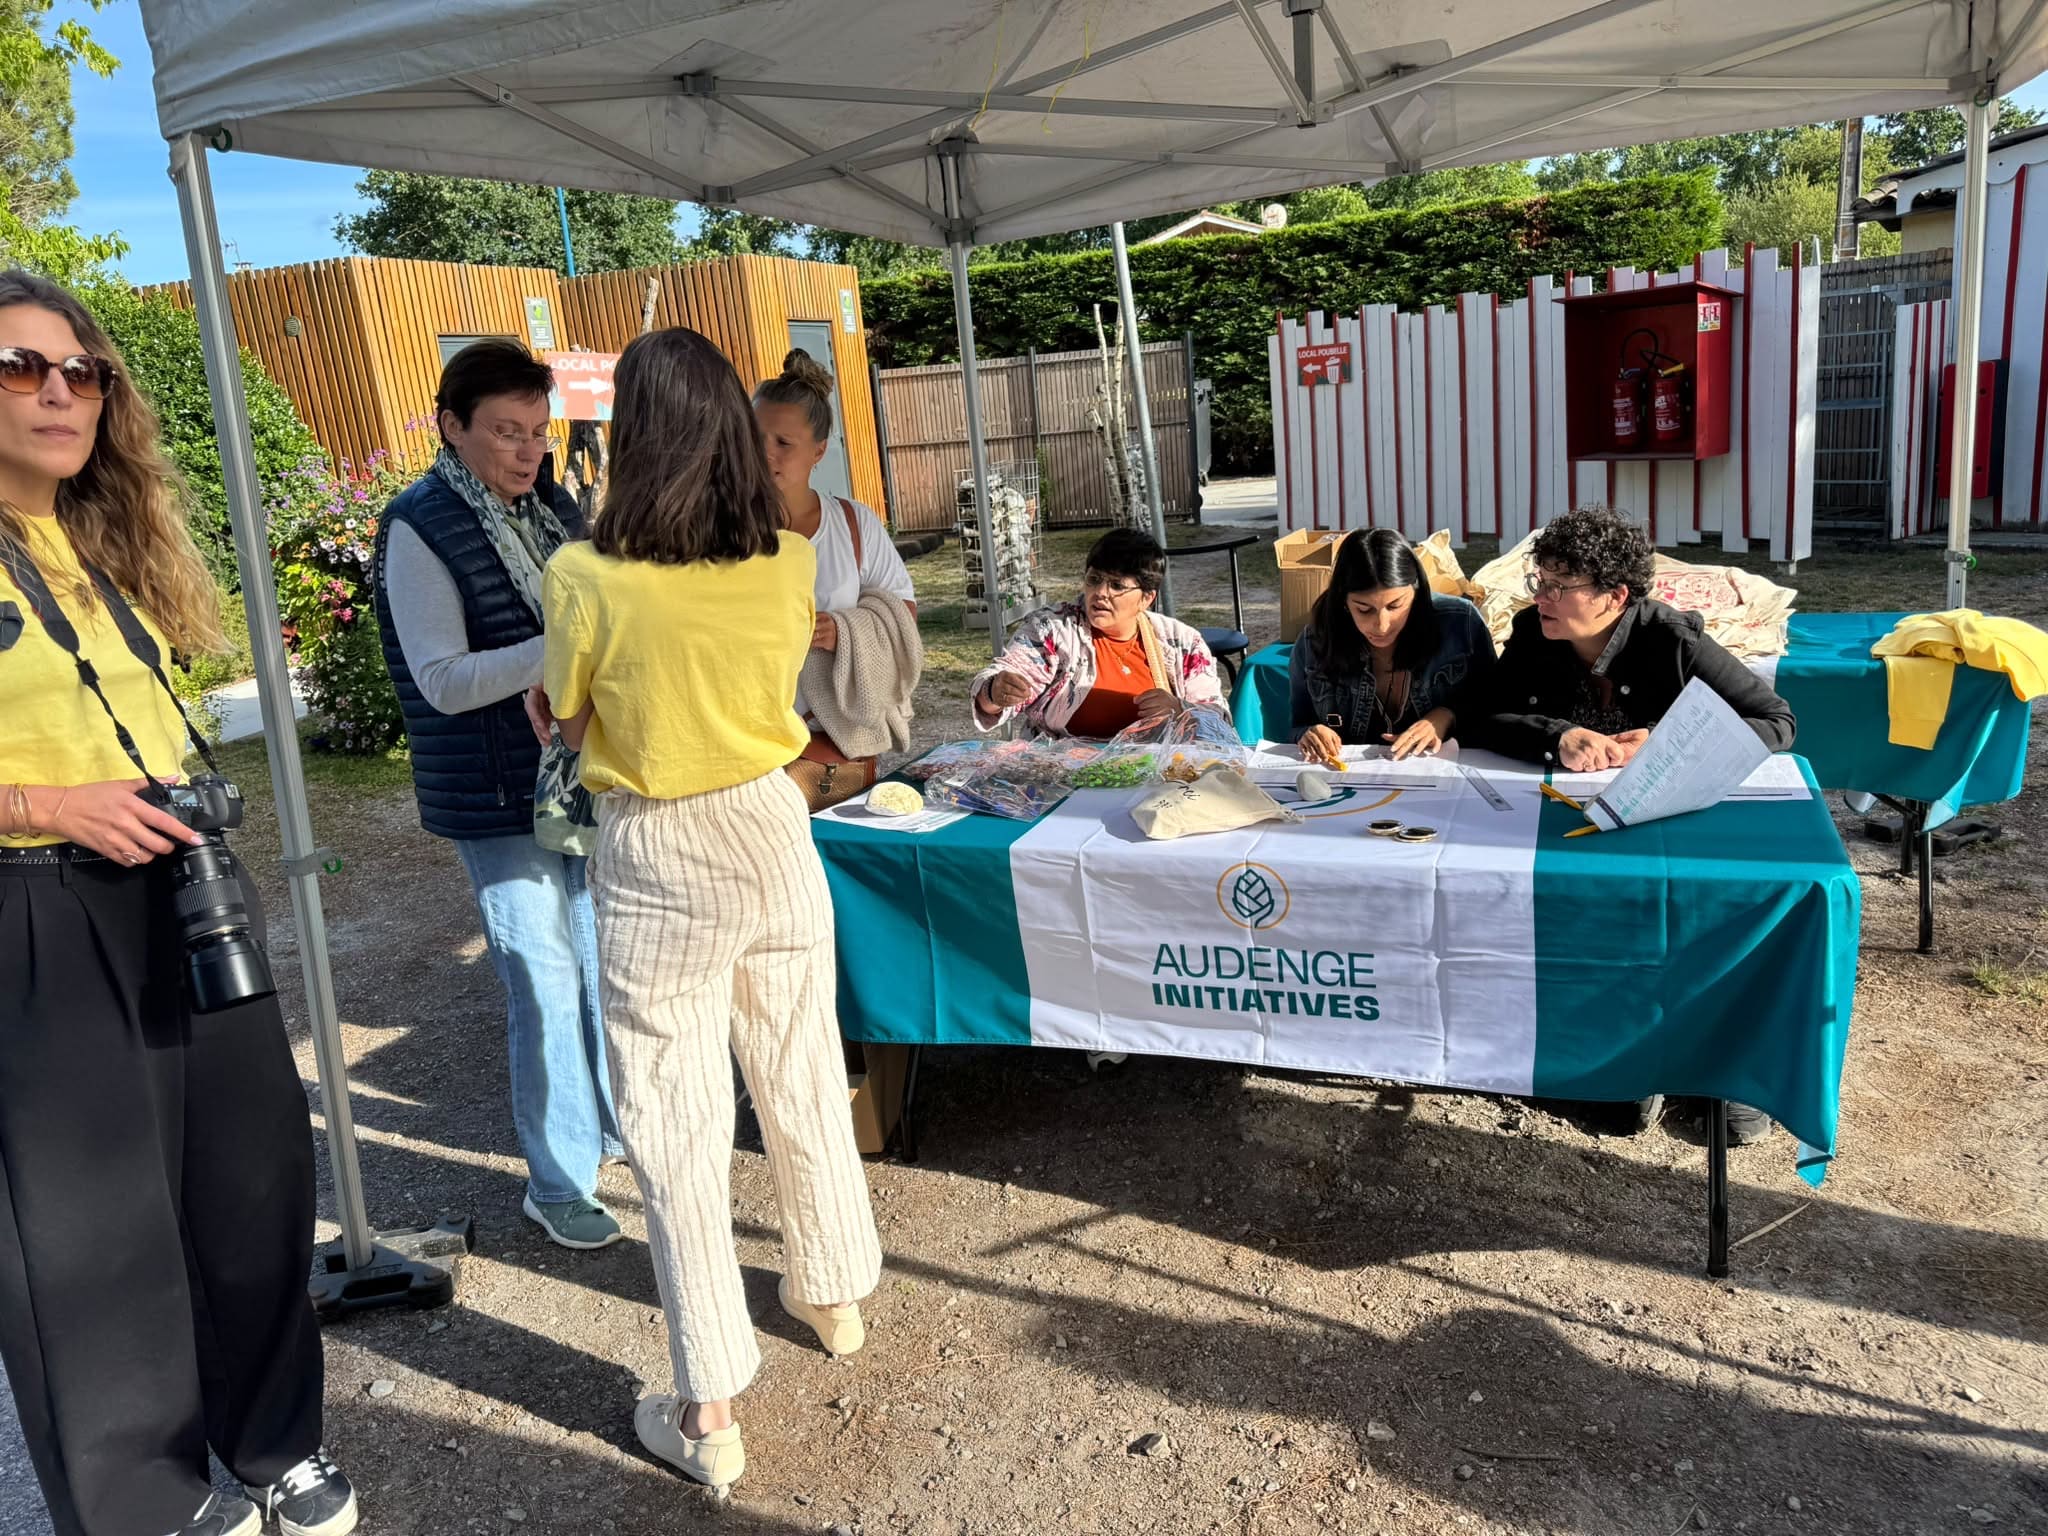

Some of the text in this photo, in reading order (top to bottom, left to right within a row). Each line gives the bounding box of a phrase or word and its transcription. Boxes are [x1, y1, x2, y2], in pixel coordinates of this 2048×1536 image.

[549, 358, 597, 371] LOCAL
[1298, 349, 1317, 359] LOCAL
[1153, 944, 1377, 989] AUDENGE
[1152, 983, 1380, 1021] INITIATIVES
